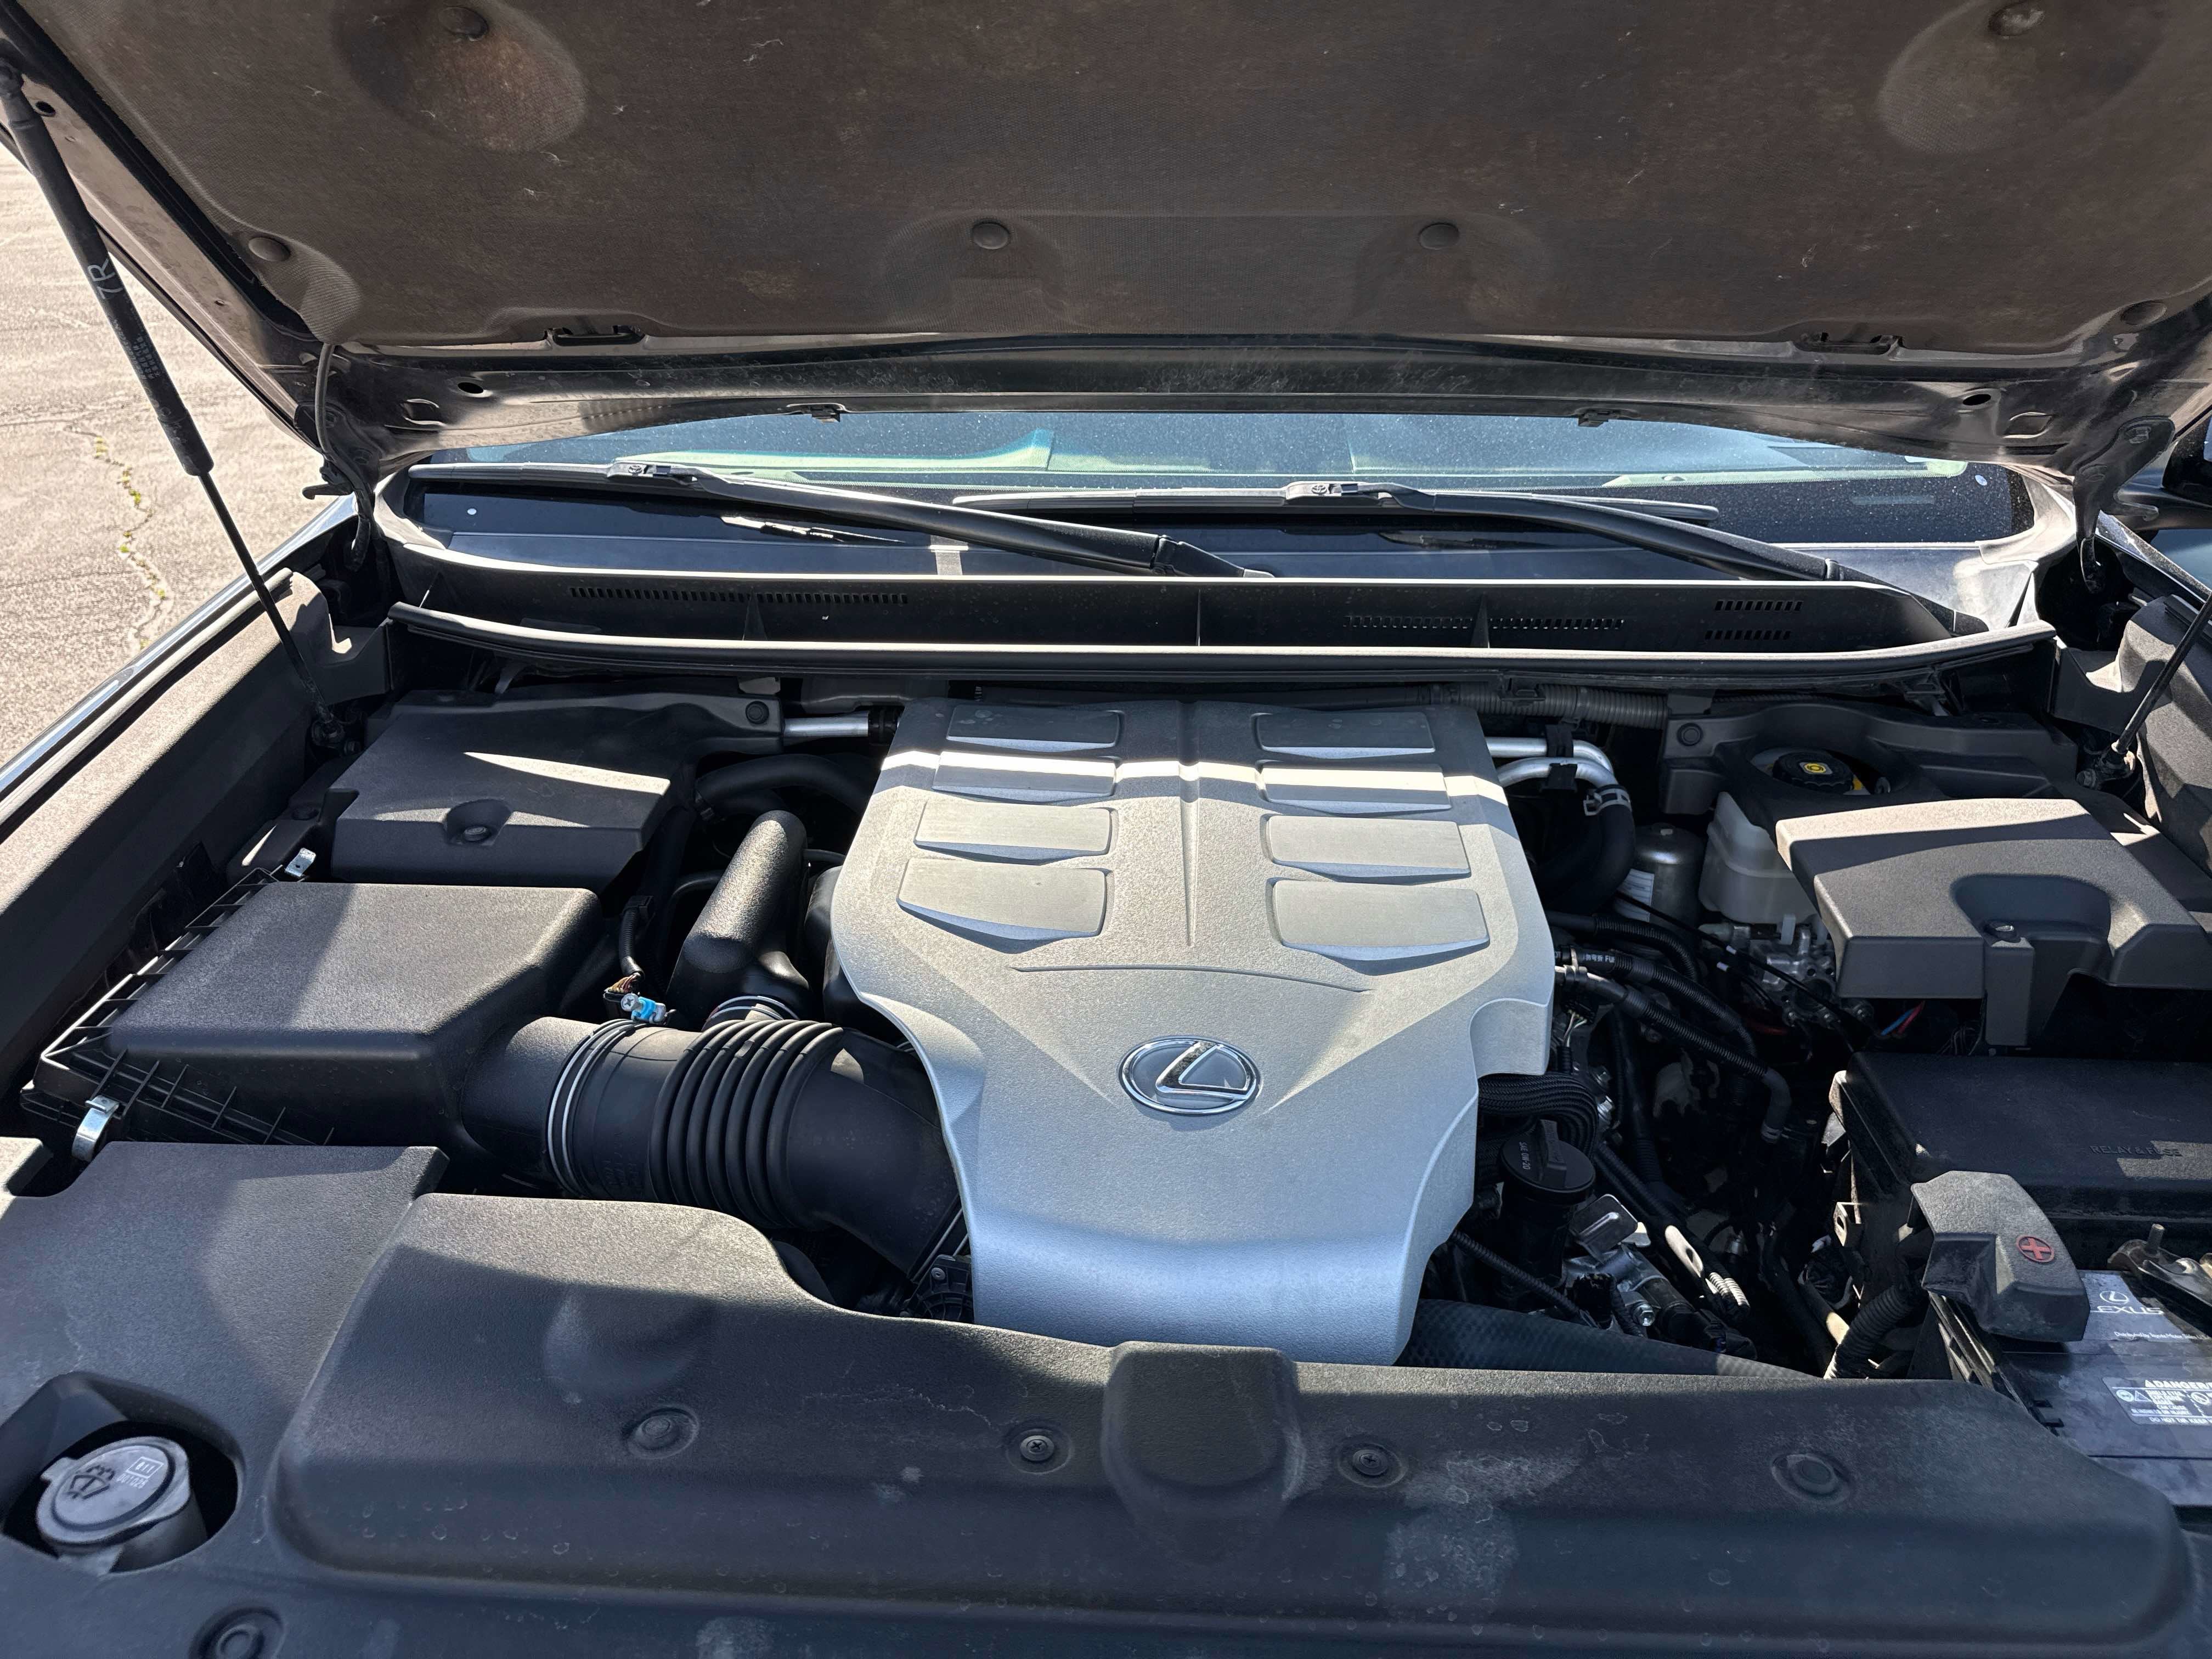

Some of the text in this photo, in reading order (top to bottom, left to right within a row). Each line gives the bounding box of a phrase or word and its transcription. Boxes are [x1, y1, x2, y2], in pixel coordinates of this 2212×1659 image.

[2089, 1146, 2131, 1155] RELAY
[2146, 1147, 2183, 1157] FUSE
[2090, 1306, 2164, 1315] EXUS
